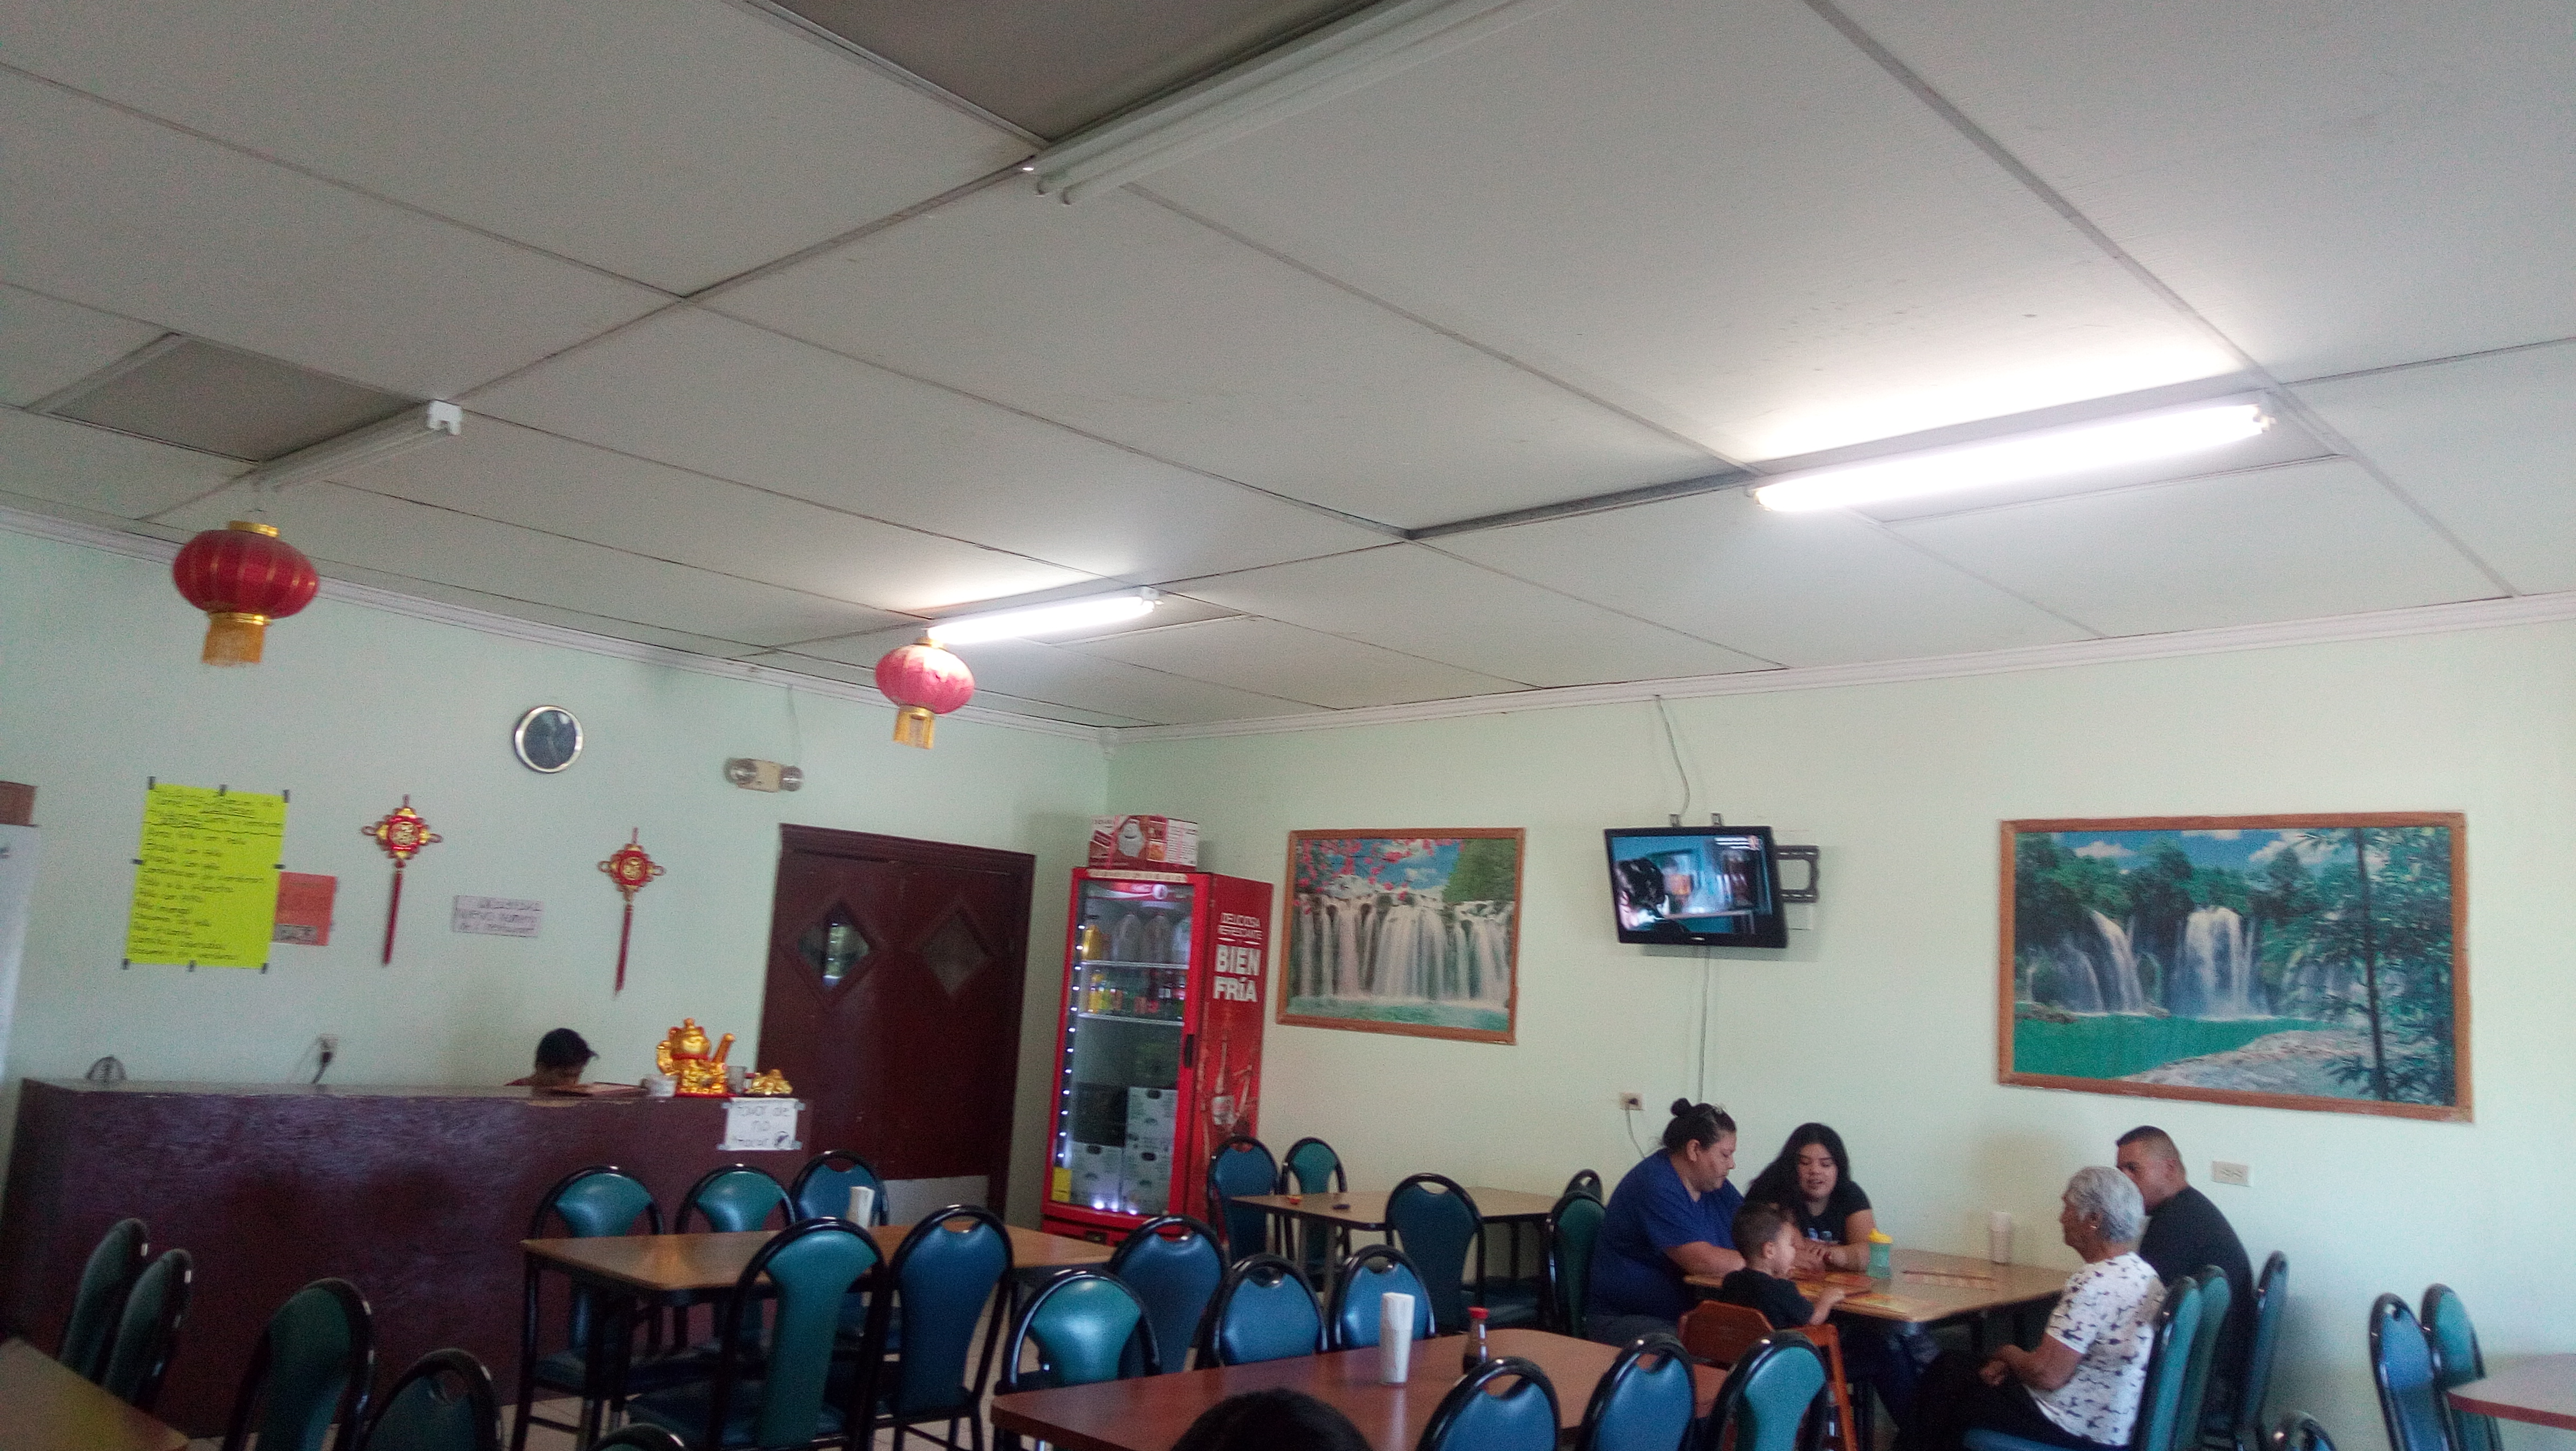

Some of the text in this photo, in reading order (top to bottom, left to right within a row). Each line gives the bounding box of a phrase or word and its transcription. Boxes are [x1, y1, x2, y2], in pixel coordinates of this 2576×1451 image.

[1220, 912, 1261, 928] DELICIOSA
[1217, 925, 1262, 940] REFRESCANTE
[1214, 943, 1262, 976] BIEN
[1213, 976, 1258, 1002] FRÍA
